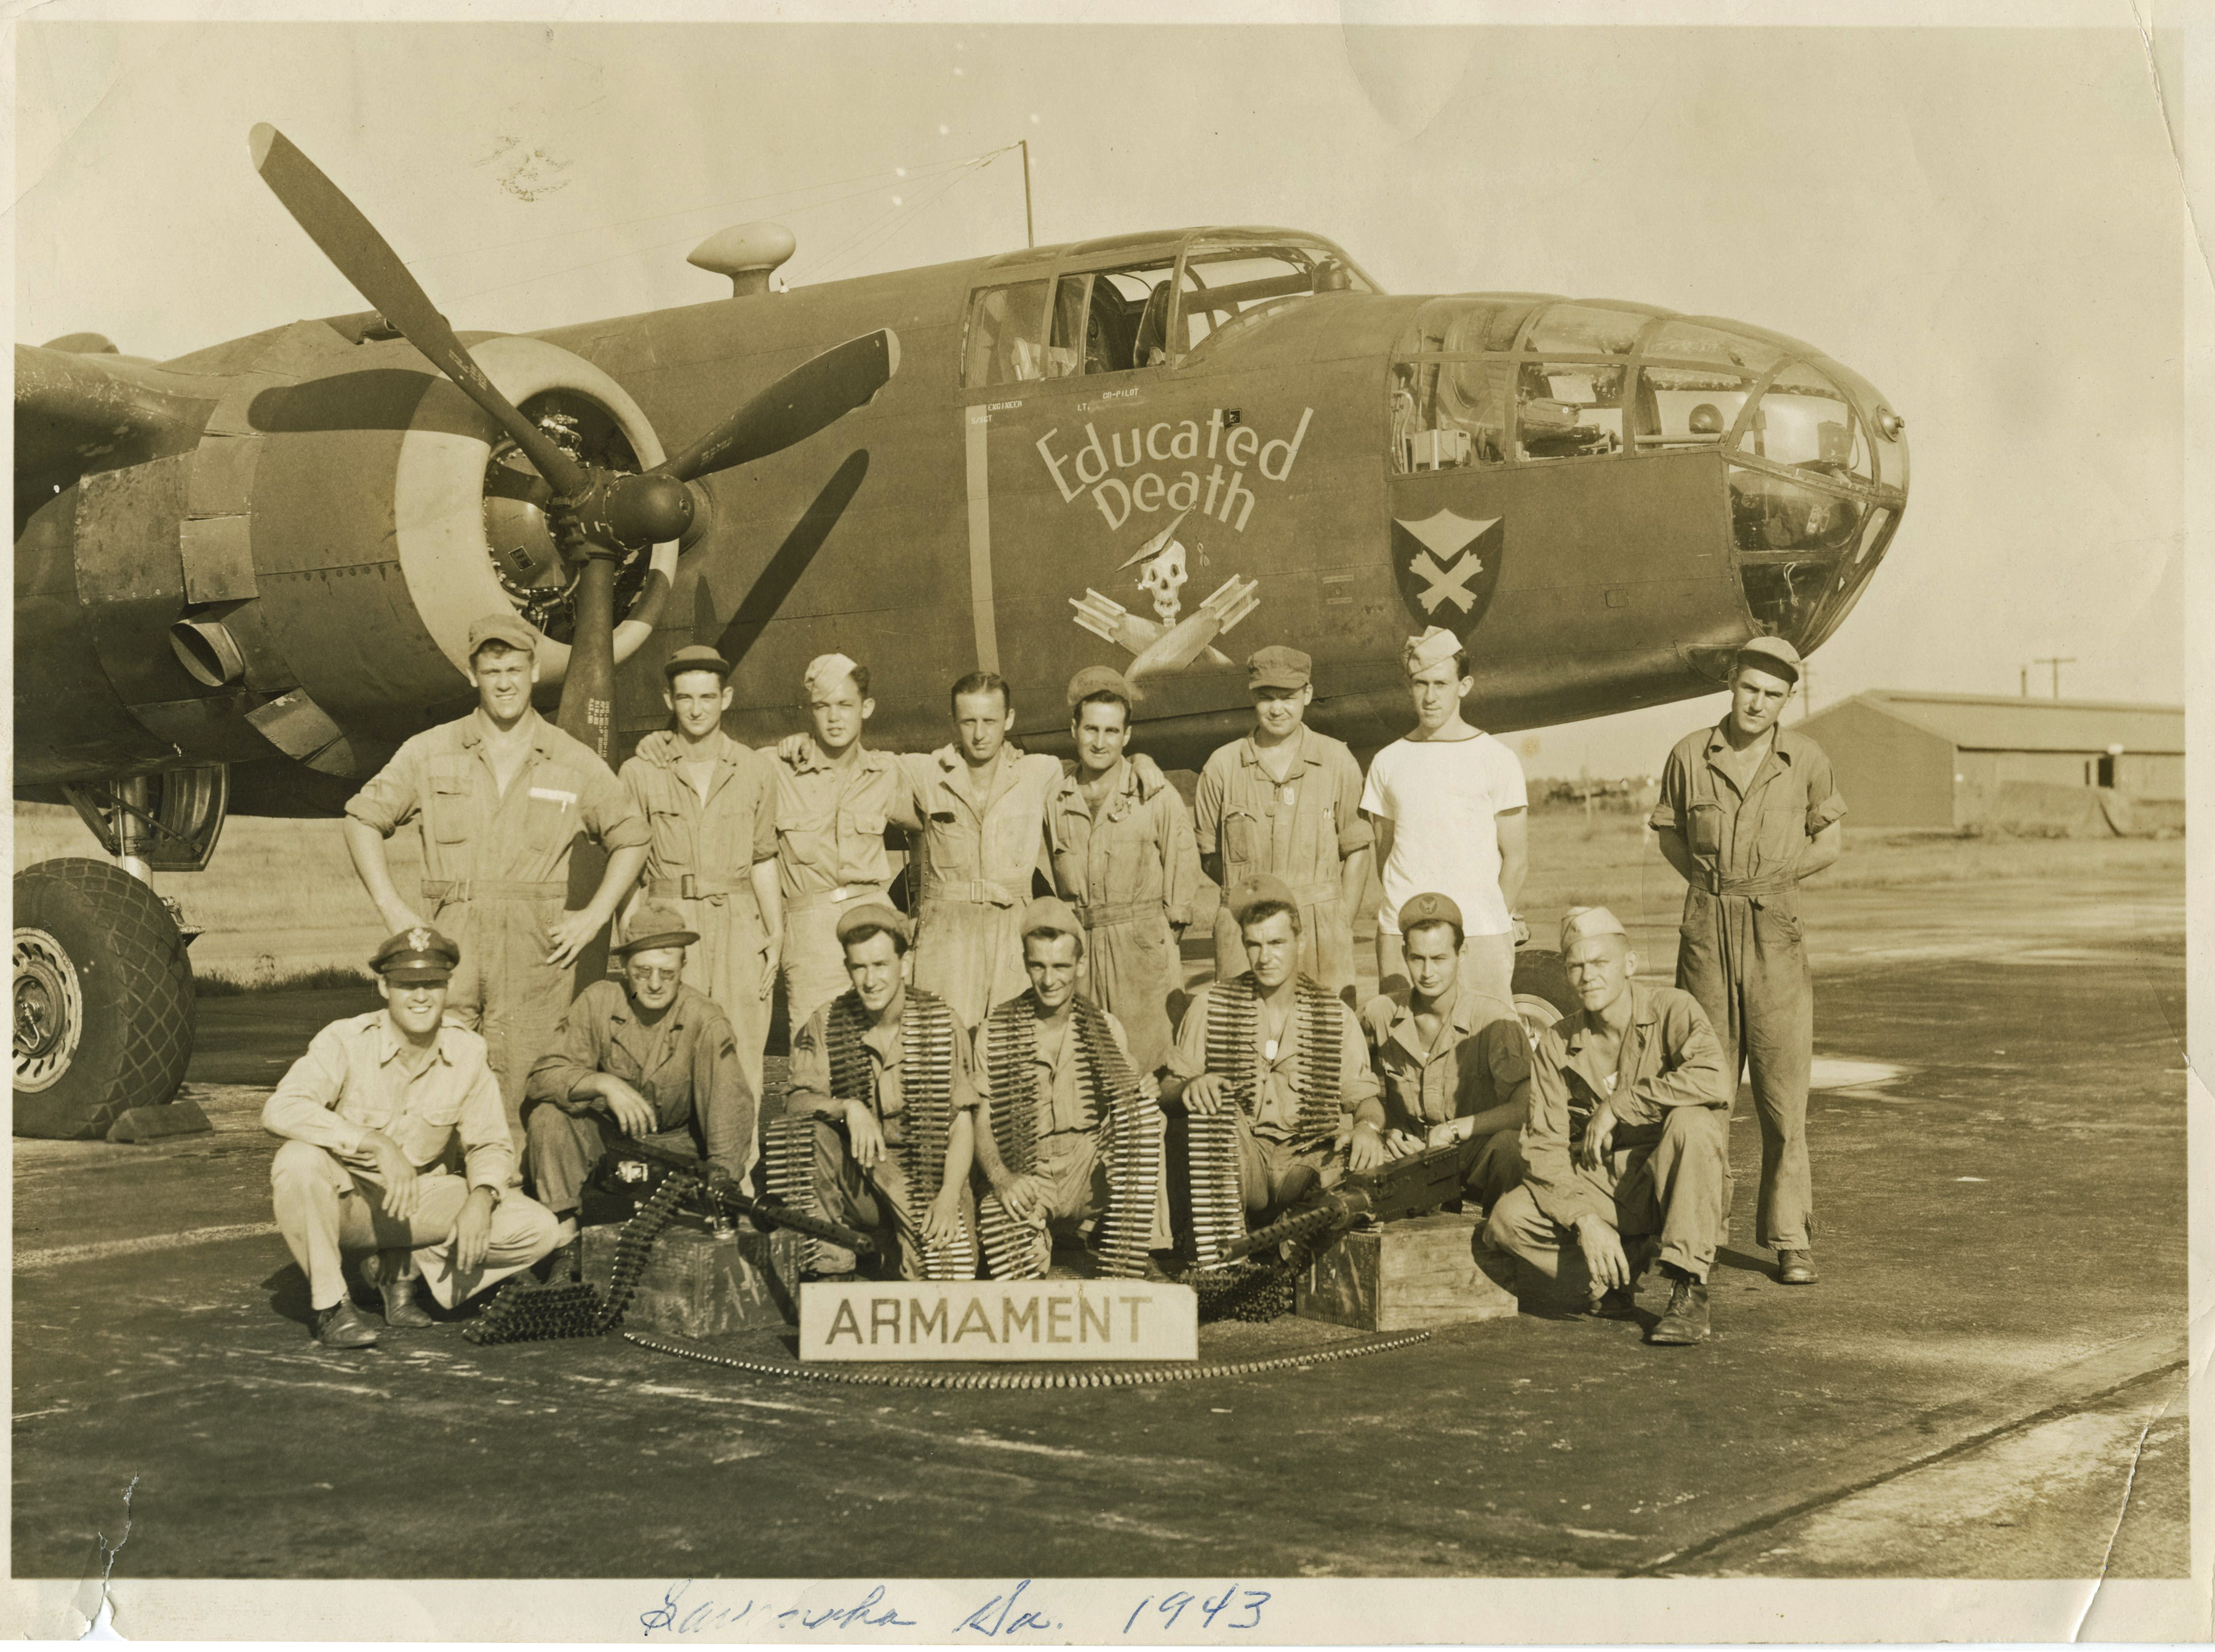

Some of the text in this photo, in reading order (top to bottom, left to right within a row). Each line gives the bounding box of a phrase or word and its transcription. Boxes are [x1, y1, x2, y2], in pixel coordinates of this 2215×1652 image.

[988, 401, 1023, 411] ENGINEER
[1103, 388, 1139, 399] CO-PILOT
[971, 415, 993, 425] S/SGT
[1036, 407, 1314, 503] Educated
[1092, 463, 1255, 532] Death
[824, 1296, 1153, 1345] ARMAMENT
[1123, 1583, 1272, 1634] 1943
